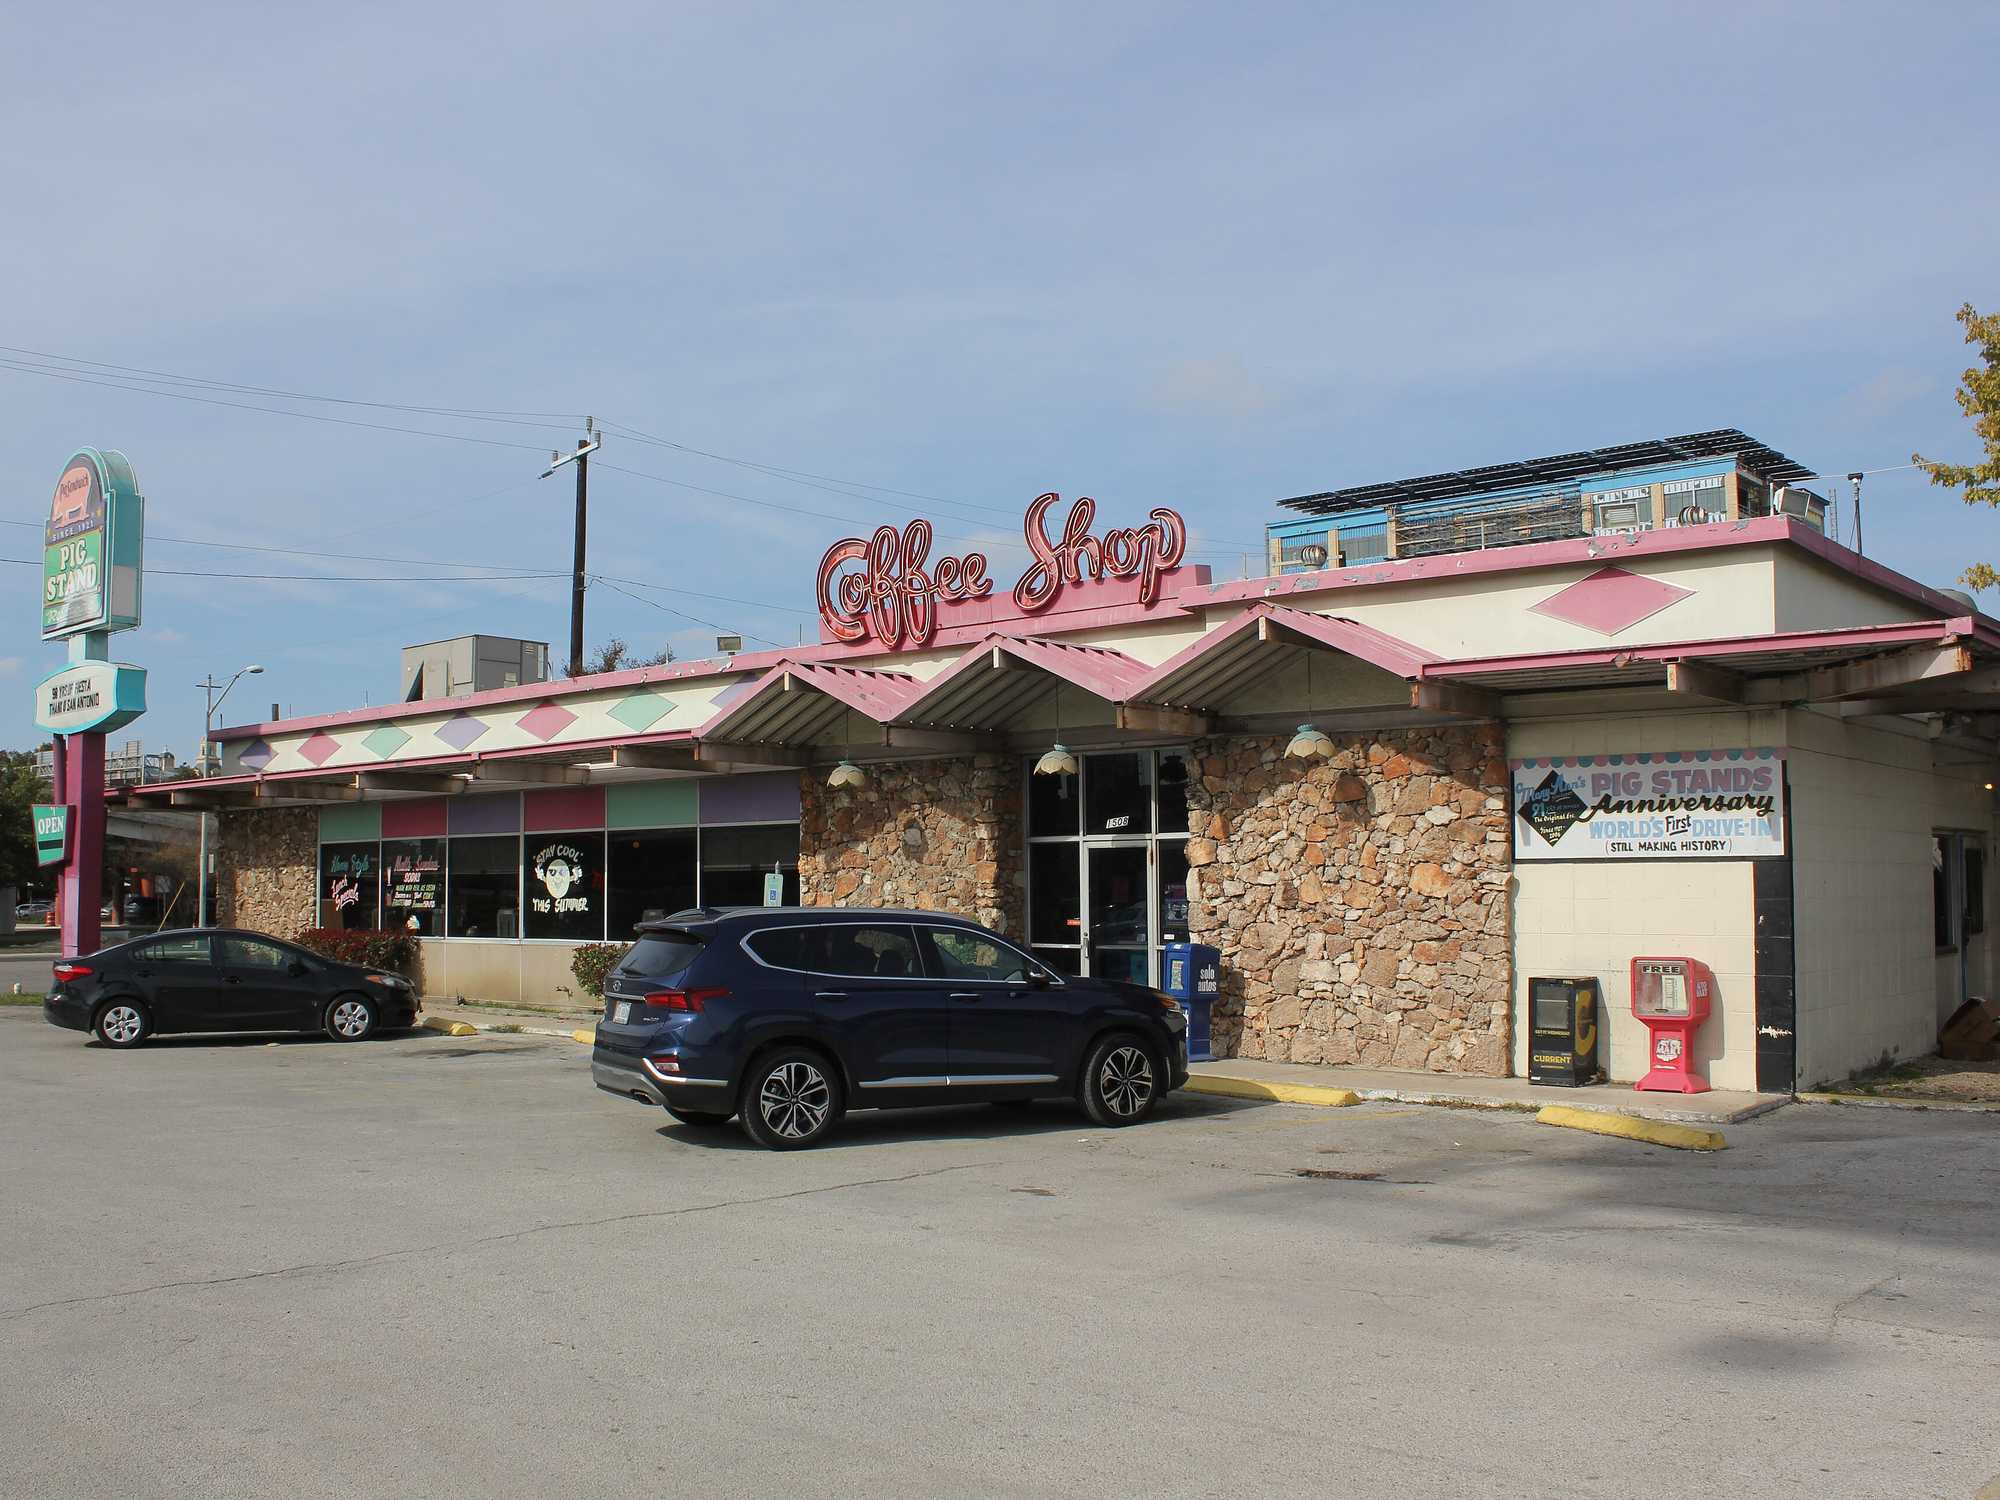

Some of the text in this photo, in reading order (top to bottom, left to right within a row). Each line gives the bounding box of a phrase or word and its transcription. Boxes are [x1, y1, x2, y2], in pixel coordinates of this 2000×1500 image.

[52, 526, 75, 542] SINCE
[60, 538, 87, 571] PIG
[816, 493, 1186, 648] Coffee Shop
[47, 563, 98, 602] STAND
[77, 692, 100, 709] ANTONIO
[1591, 766, 1773, 797] PIG STANDS
[1580, 793, 1775, 823] Anniversary
[38, 816, 64, 833] OPEN
[1107, 816, 1129, 828] 1508
[1589, 814, 1773, 839] WORLD'S First DRIVE-IN
[1605, 838, 1733, 856] (STILL MAKING HISTORY)
[532, 897, 588, 913] THIS SUMMER
[1200, 963, 1215, 980] solo
[1642, 965, 1681, 974] FREE
[1197, 979, 1217, 993] autos
[1533, 1054, 1572, 1064] CURRENT
